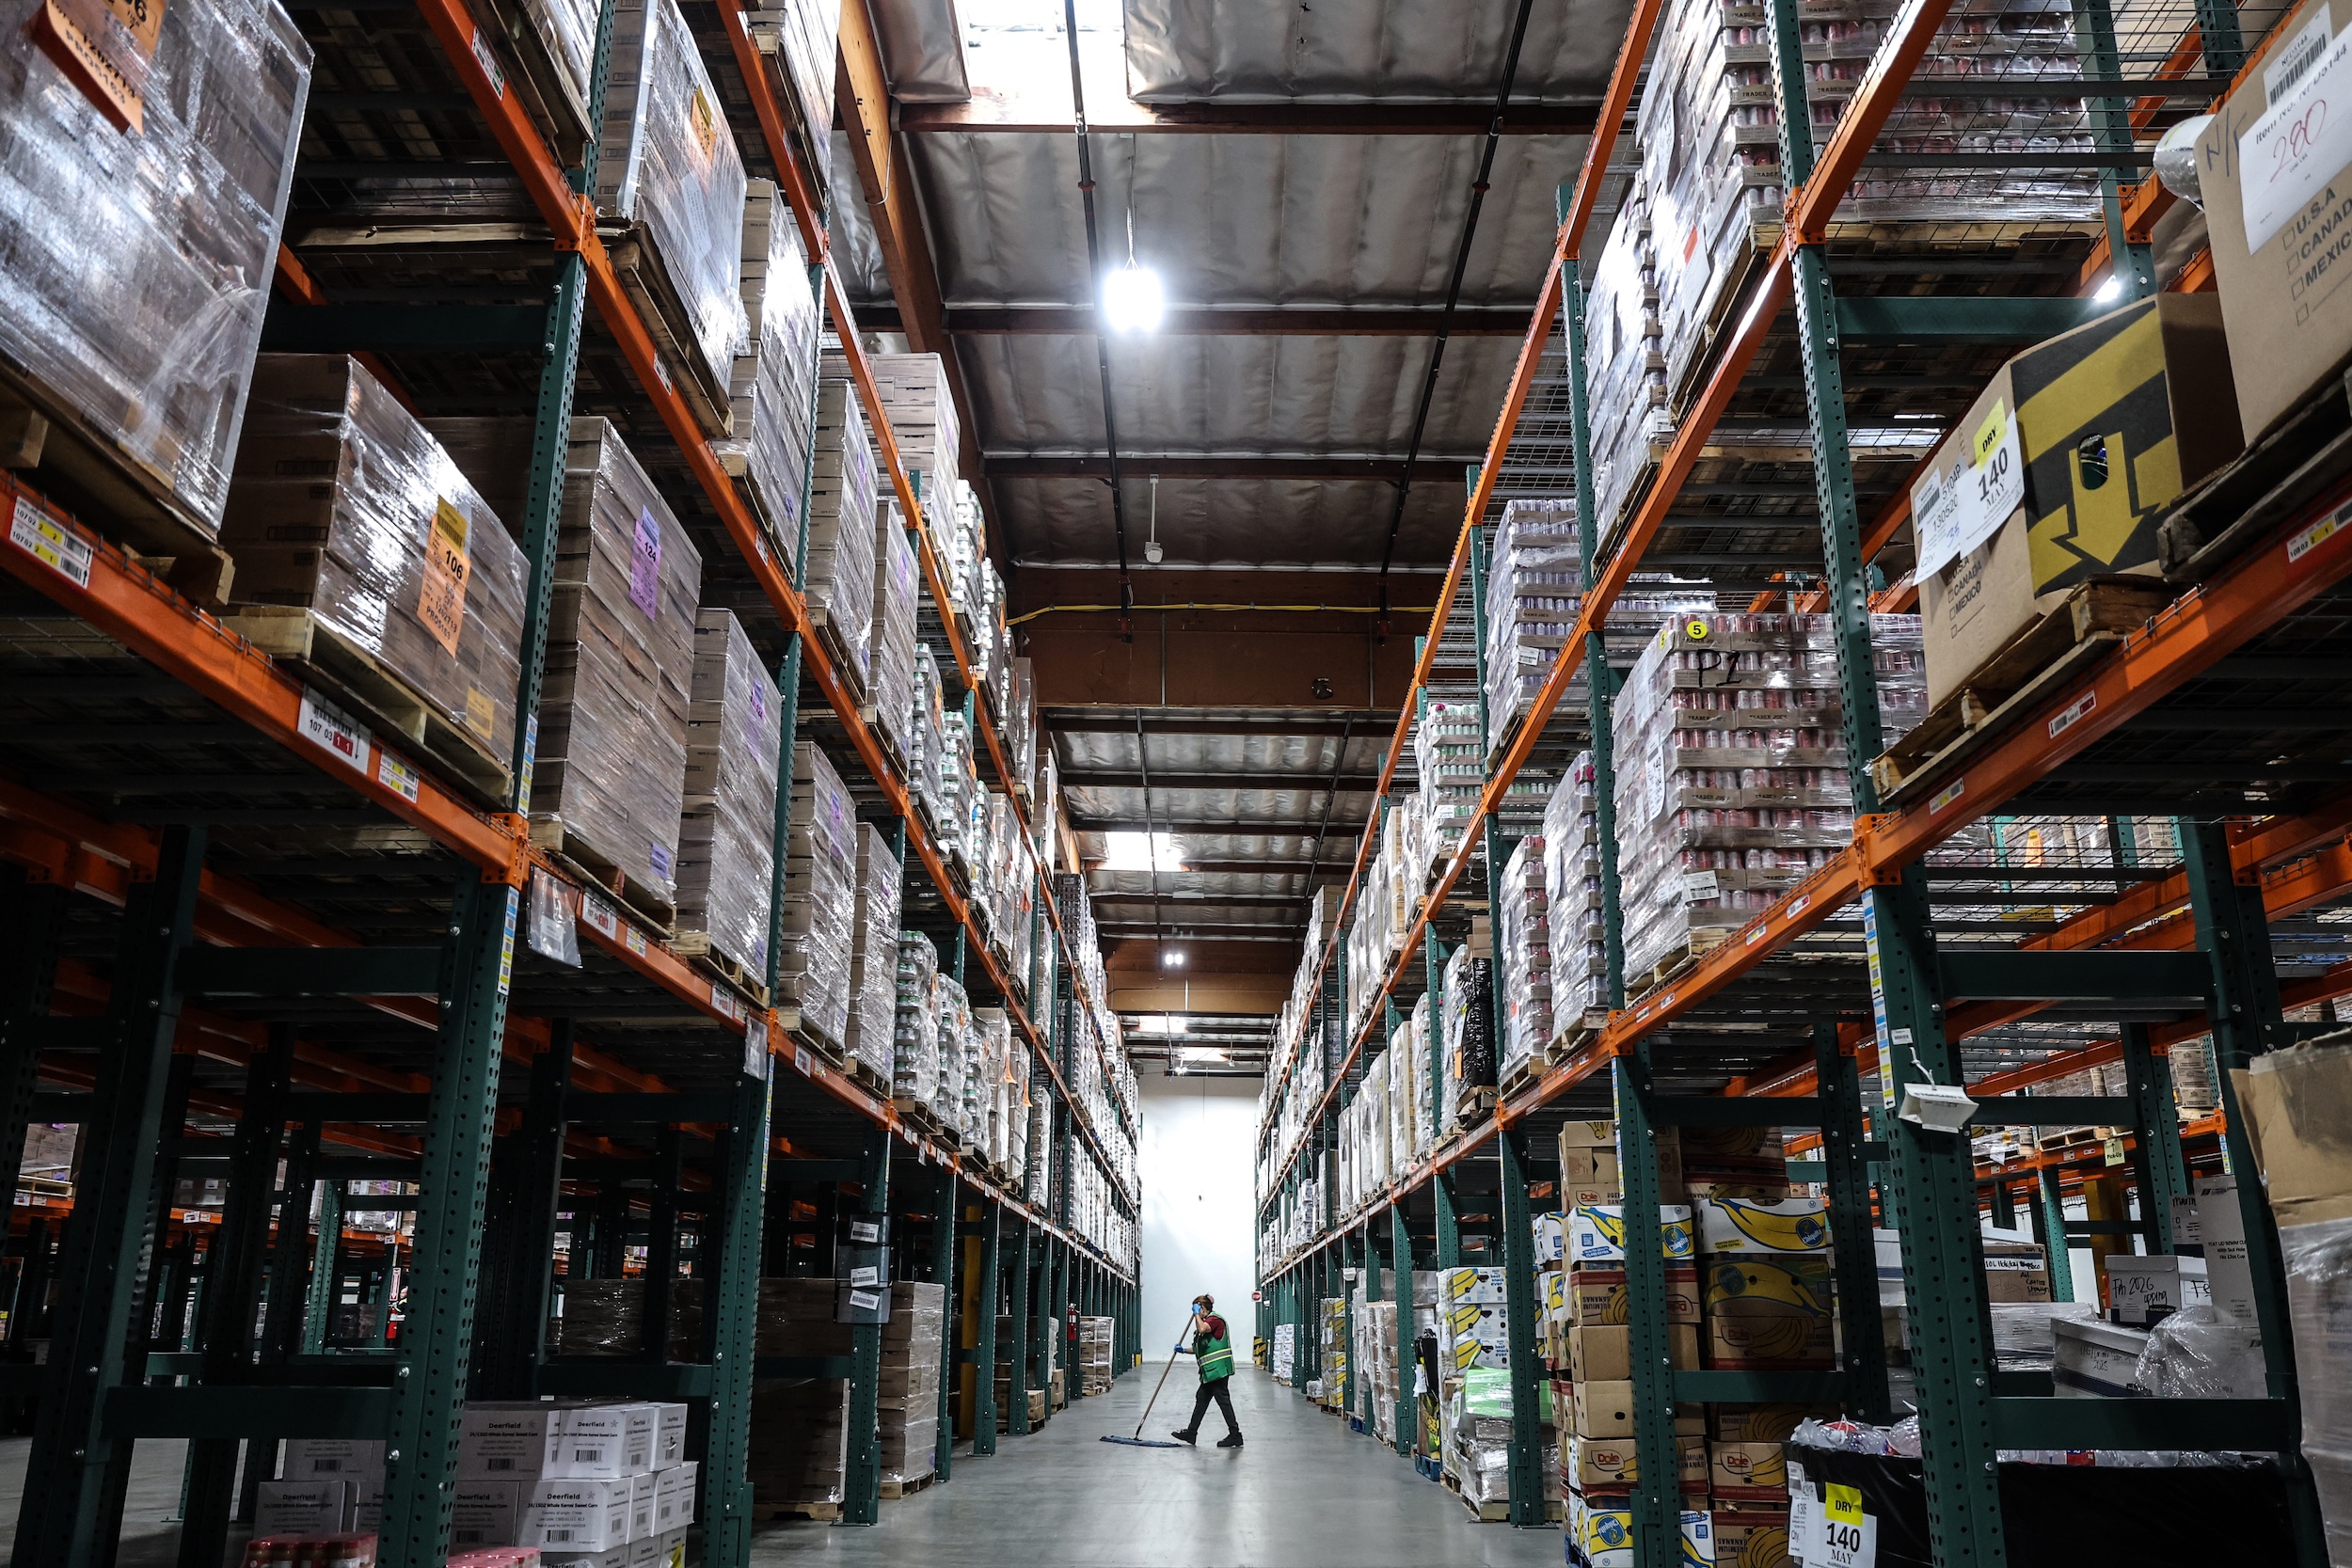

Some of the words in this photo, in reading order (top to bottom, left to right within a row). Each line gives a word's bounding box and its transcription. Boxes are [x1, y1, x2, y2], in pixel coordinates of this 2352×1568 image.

[2269, 99, 2327, 183] 280
[2296, 187, 2336, 235] U.S.A
[1982, 426, 1996, 453] DRY
[1978, 447, 2009, 502] 140
[1984, 478, 2006, 510] MAY
[644, 542, 657, 562] 124
[446, 549, 463, 580] 106
[1954, 560, 1982, 596] CANADA
[1955, 580, 1981, 614] MEXICO
[1692, 625, 1701, 635] 5
[310, 719, 323, 734] 107
[324, 729, 333, 741] 03
[336, 736, 341, 746] 1
[345, 742, 350, 752] 1
[1669, 1236, 1689, 1251] Chiquita
[1803, 1229, 1822, 1244] Chiquita
[2129, 1276, 2154, 1295] 2026
[1728, 1330, 1751, 1339] Dole
[1597, 1453, 1619, 1463] Dole
[1727, 1456, 1750, 1465] Dole
[1836, 1500, 1853, 1513] DRY
[1597, 1518, 1619, 1534] Chiquita
[1826, 1523, 1861, 1553] 140
[1831, 1549, 1853, 1564] MAY
